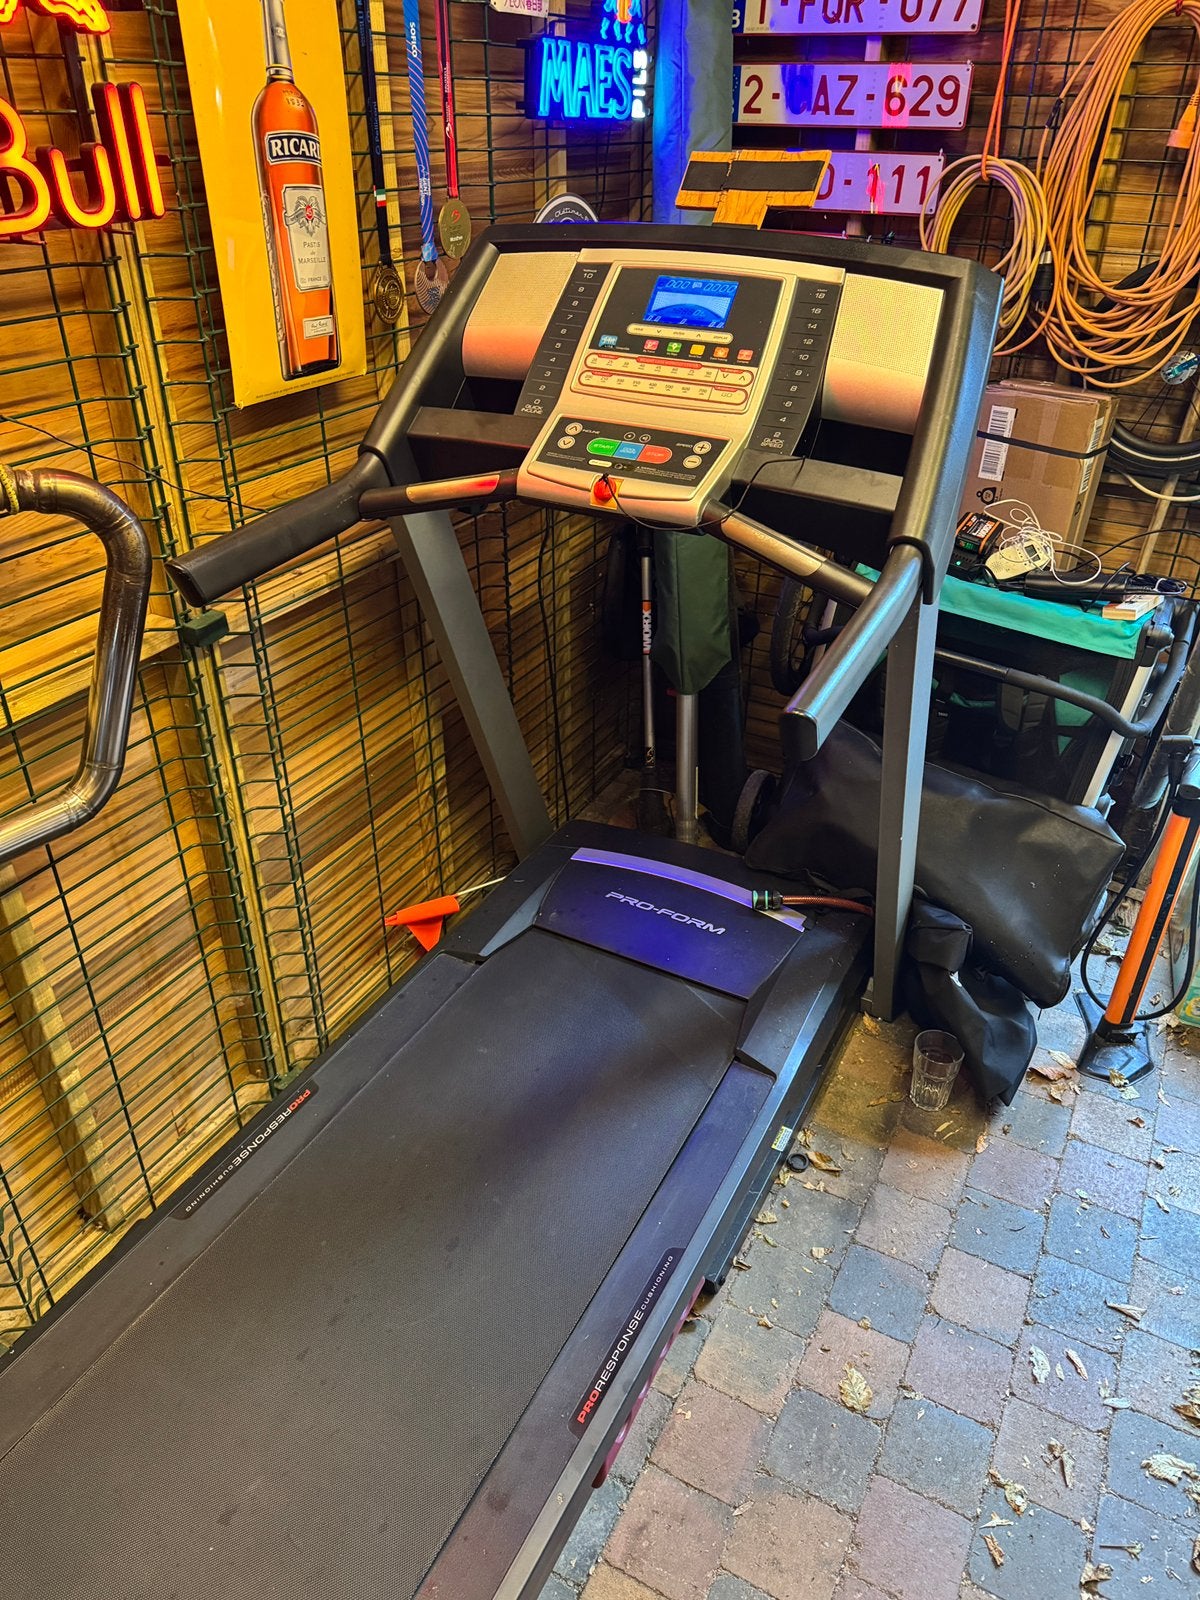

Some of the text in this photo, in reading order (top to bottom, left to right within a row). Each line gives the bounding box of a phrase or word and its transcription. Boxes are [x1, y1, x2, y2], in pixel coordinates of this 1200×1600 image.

[409, 21, 418, 58] SOFICO
[538, 38, 632, 119] MAES
[632, 50, 648, 118] PILS
[0, 81, 166, 236] Bull
[270, 137, 321, 159] RICAR
[605, 891, 726, 936] PRO-FORM
[186, 1089, 311, 1212] PRORESPONSE CUSHIONING
[577, 1255, 674, 1424] PRORESPONSE CUSHIONING
